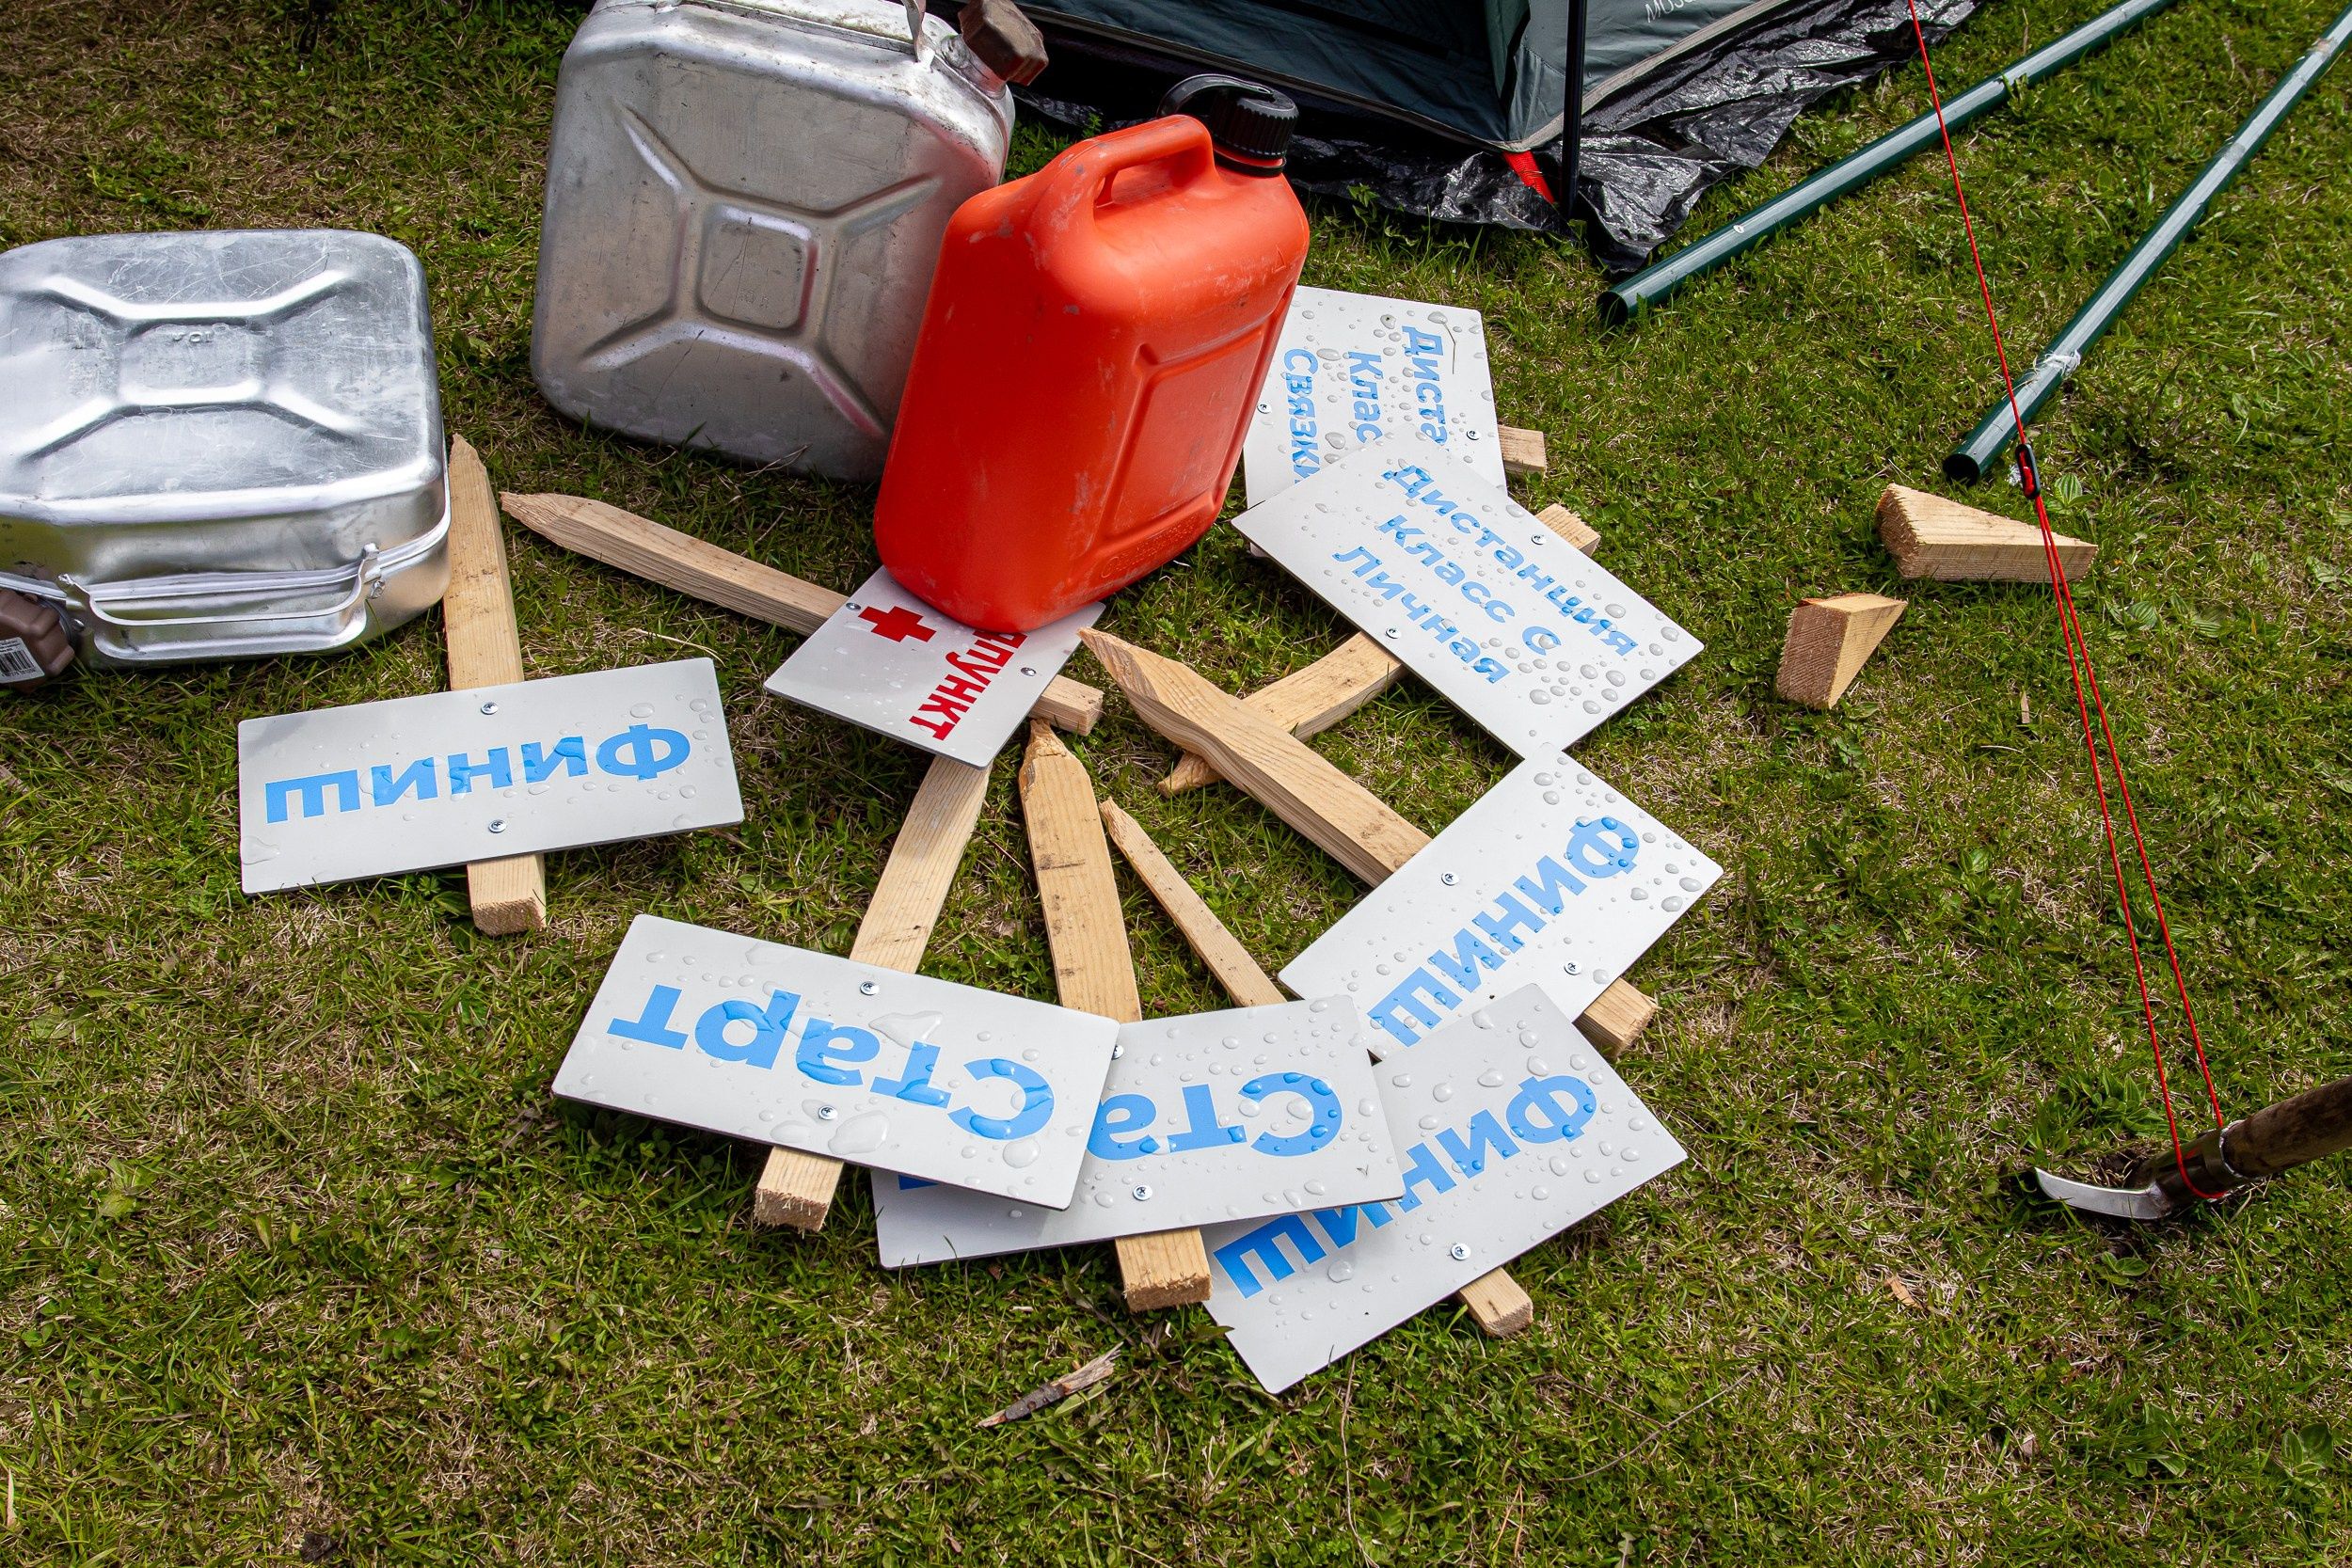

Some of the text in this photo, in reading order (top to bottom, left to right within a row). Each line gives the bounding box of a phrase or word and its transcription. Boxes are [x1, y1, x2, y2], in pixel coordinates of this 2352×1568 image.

[1402, 325, 1450, 451] Диста
[1332, 546, 1511, 684] Личная
[1378, 515, 1515, 623] Класс
[1381, 465, 1638, 657] Дистанция
[264, 723, 691, 824] Финиш
[1366, 816, 1640, 1048] Финиш
[606, 984, 1055, 1141] Старт
[1213, 1075, 1597, 1299] Финиш
